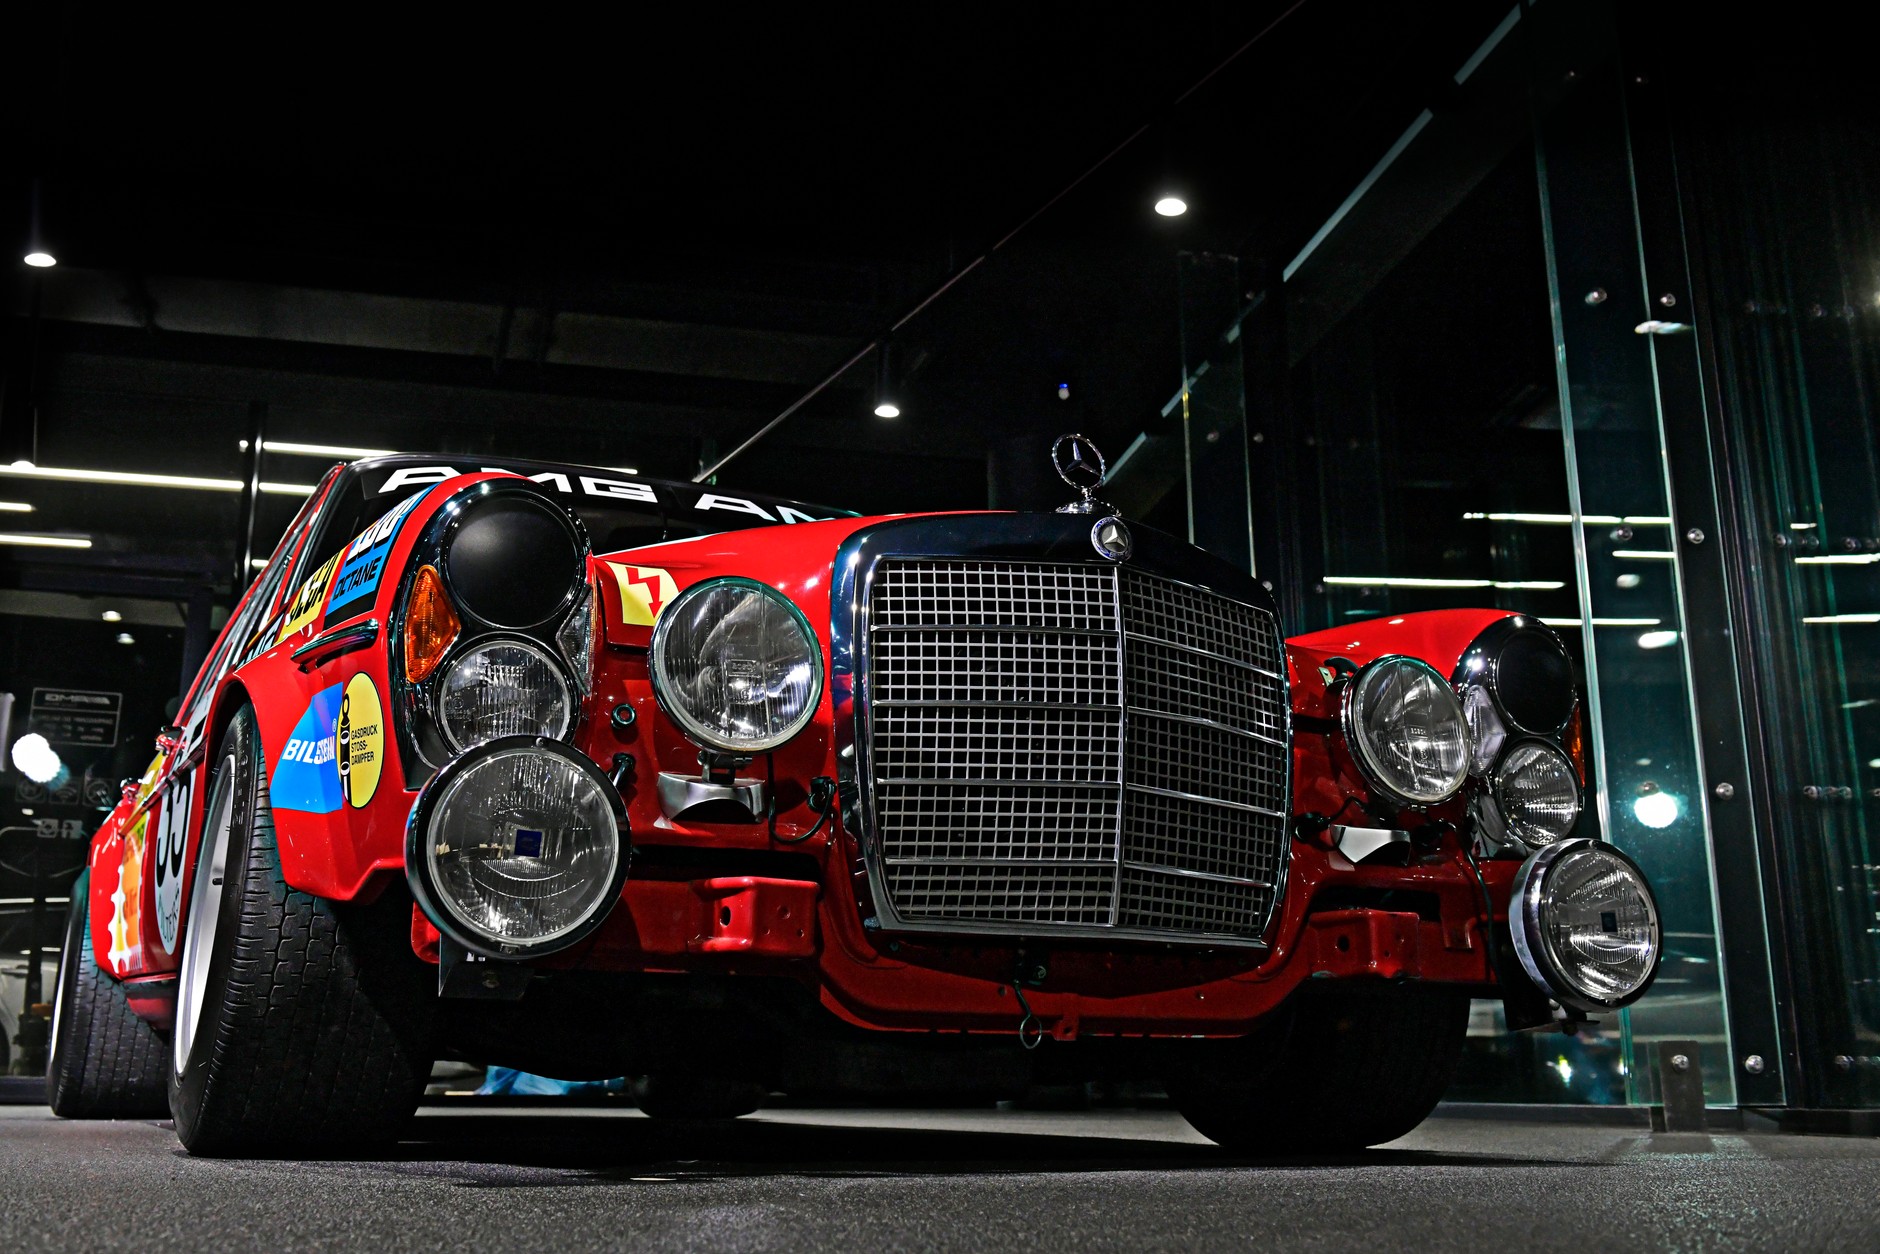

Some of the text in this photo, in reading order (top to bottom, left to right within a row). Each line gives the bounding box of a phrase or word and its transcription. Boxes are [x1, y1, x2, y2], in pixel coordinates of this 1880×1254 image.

[378, 466, 658, 503] AMG
[332, 557, 383, 601] OCTANE
[351, 724, 378, 741] GASDRUCK
